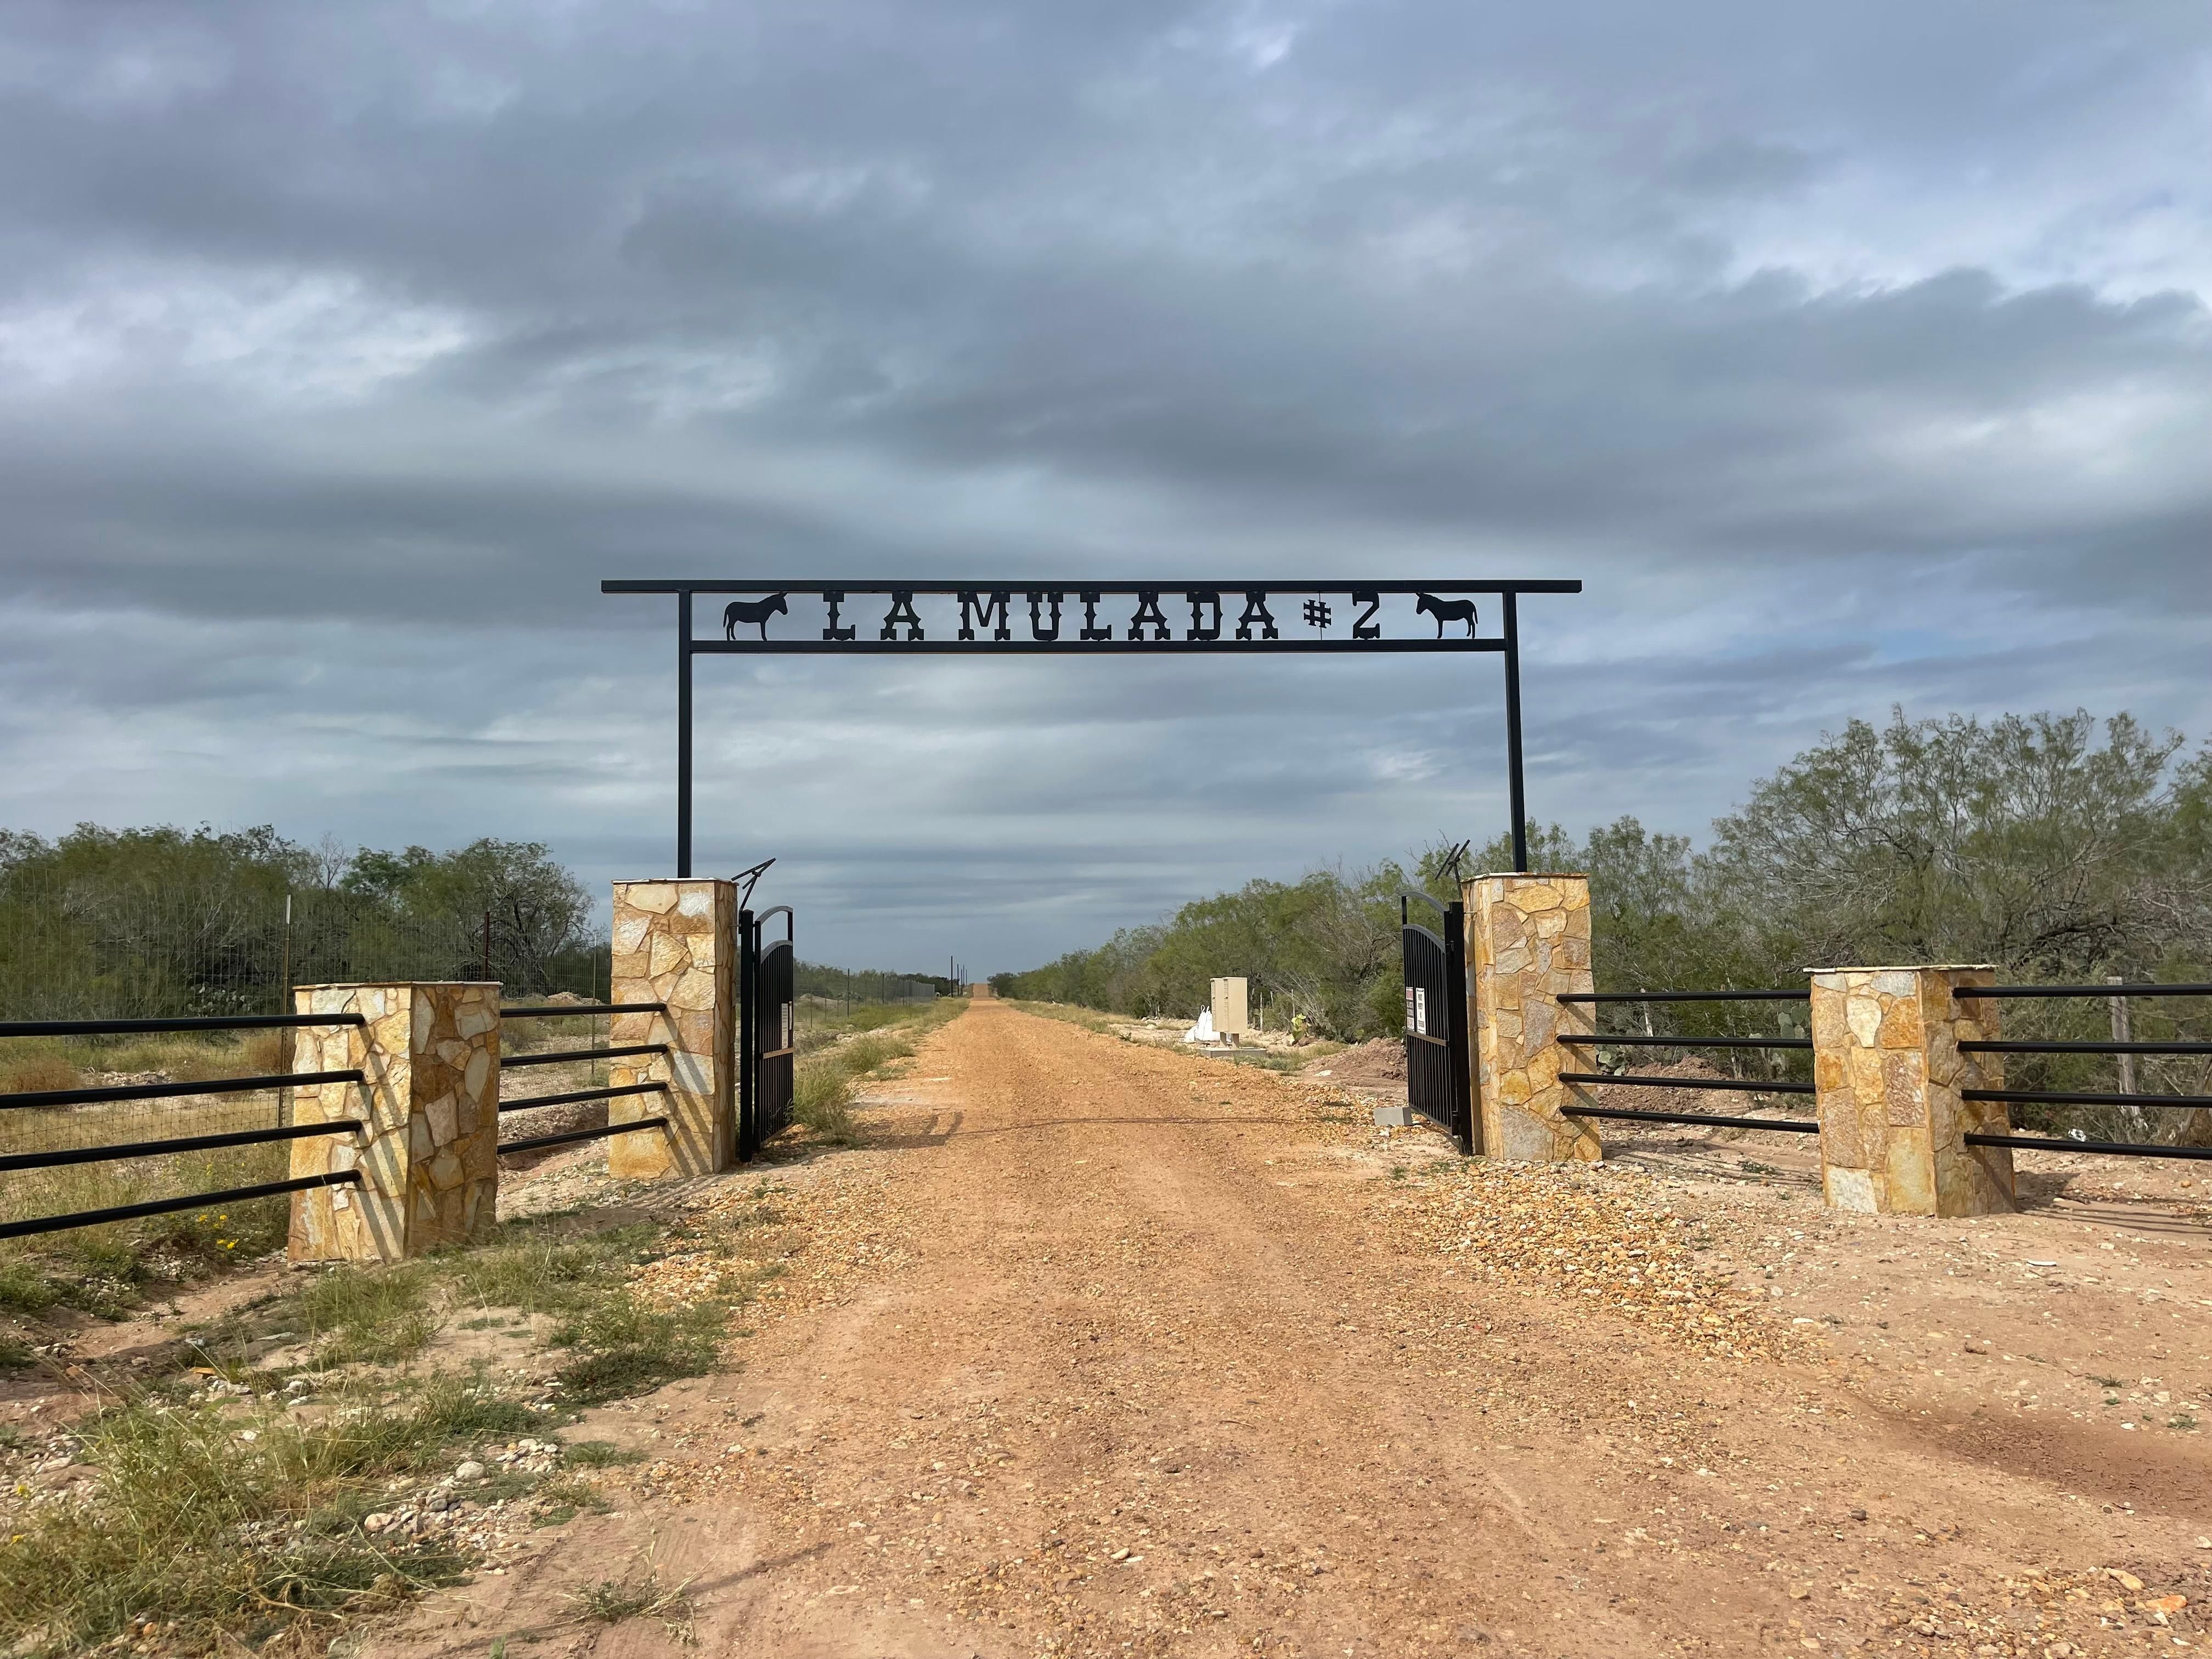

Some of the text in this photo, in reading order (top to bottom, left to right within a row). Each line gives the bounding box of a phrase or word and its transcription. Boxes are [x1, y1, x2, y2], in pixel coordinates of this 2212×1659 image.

[823, 591, 1380, 641] LA MULADA #2
